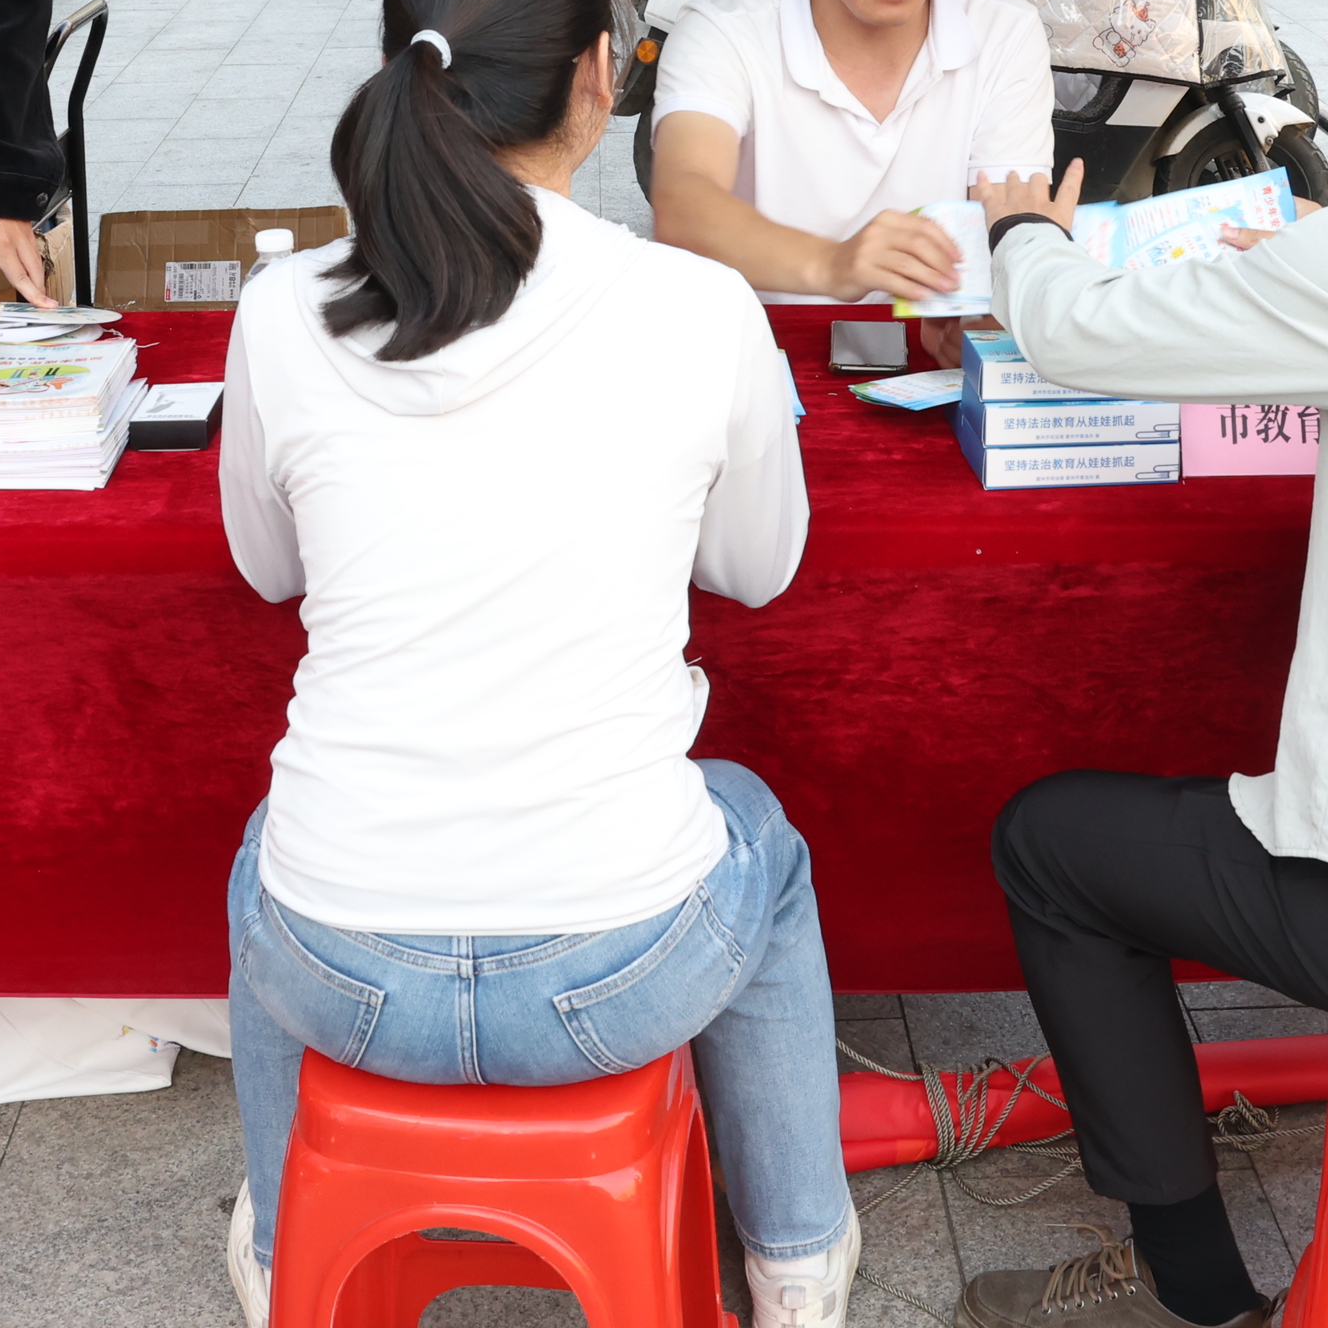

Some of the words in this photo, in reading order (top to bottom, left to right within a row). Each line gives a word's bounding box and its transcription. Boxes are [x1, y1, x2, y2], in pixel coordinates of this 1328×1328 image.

[1004, 415, 1135, 430] 坚持法治教育从娃娃抓起
[1004, 456, 1135, 471] 坚持法治教育从娃娃抓起
